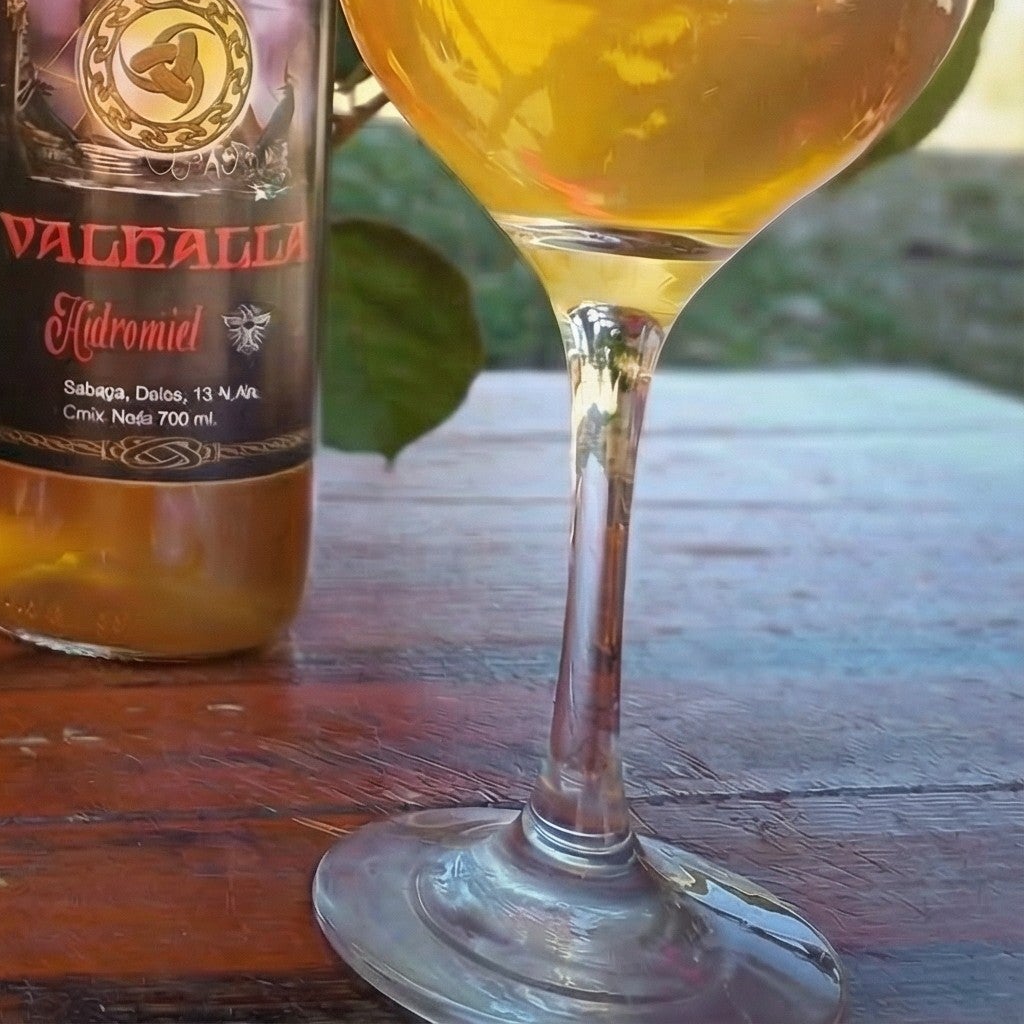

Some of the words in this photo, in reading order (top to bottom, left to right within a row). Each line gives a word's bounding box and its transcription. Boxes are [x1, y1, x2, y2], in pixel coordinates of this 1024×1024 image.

[0, 211, 307, 270] VALHALLA
[44, 291, 204, 363] Hidromiel
[194, 386, 213, 402] 13
[158, 411, 189, 427] 700
